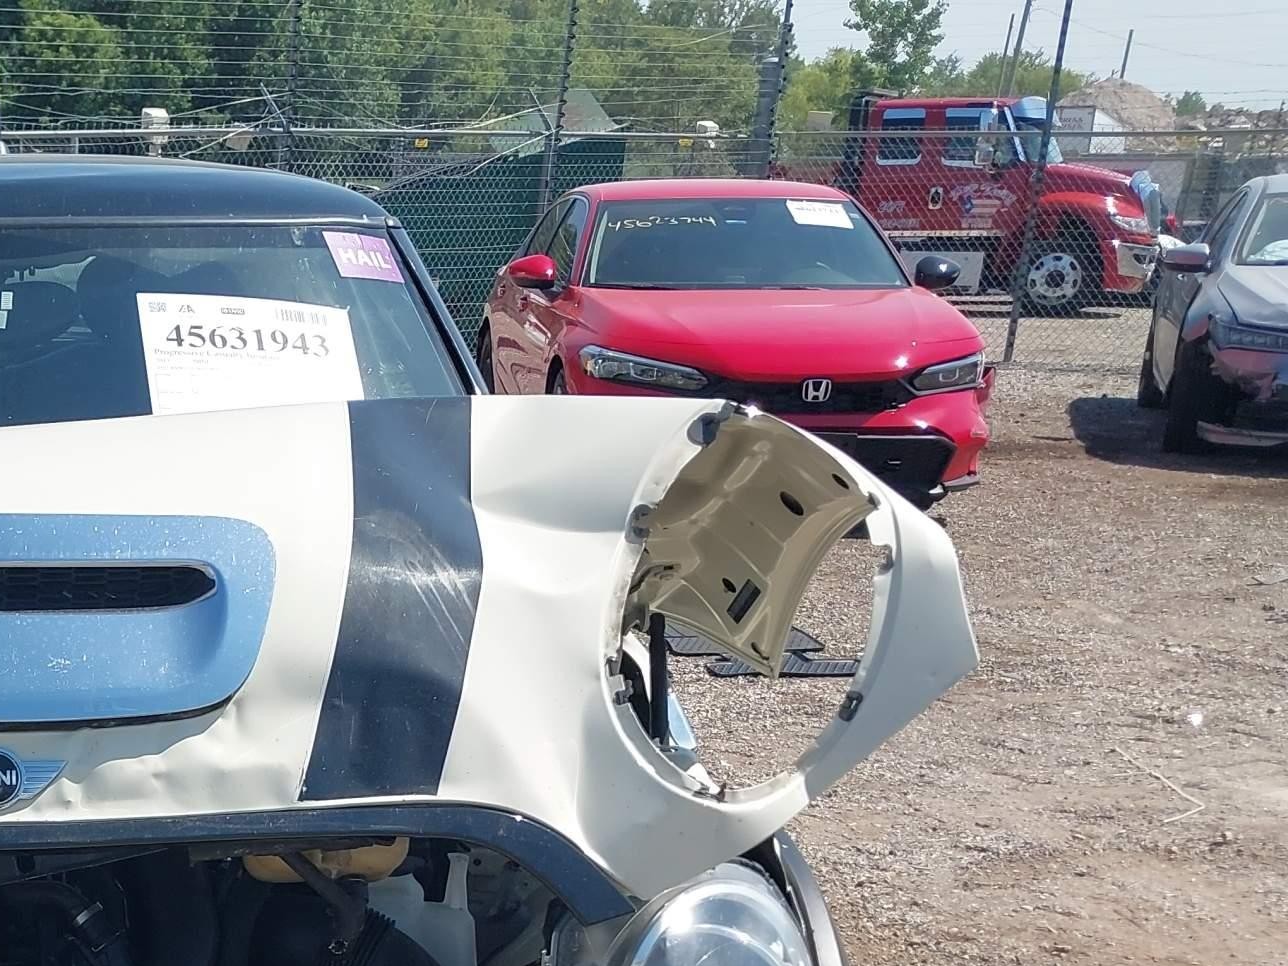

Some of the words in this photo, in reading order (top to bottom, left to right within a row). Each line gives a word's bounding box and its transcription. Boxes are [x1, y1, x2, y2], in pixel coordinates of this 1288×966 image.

[608, 216, 717, 231] 45623744
[337, 247, 393, 271] HAIL
[166, 324, 330, 359] 45631943
